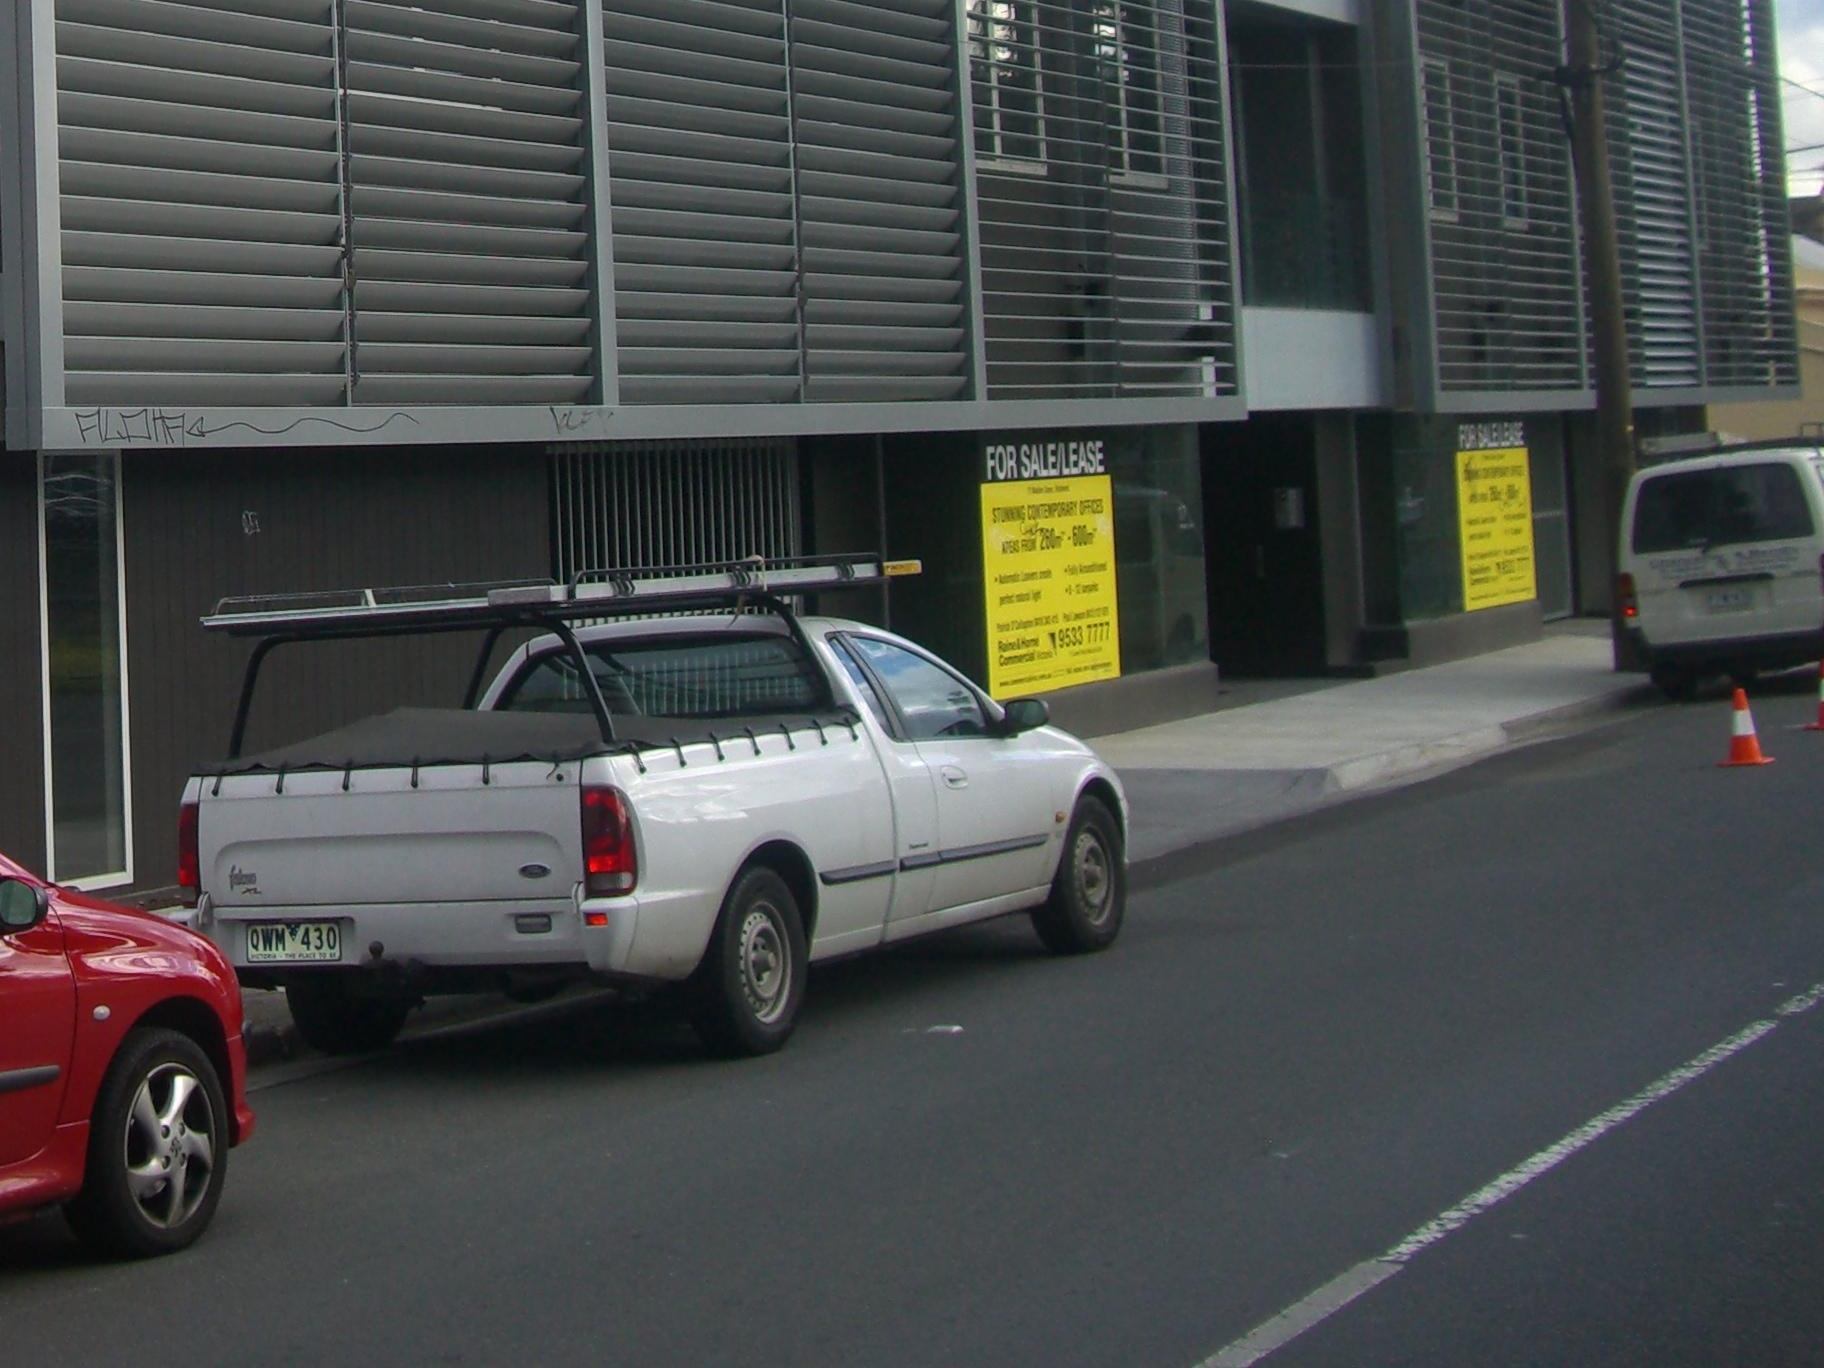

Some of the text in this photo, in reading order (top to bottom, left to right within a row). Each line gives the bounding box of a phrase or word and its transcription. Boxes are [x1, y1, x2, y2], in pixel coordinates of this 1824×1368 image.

[986, 440, 1105, 480] FOR SALE/LEASE
[1027, 500, 1078, 520] CONTEMPORARY
[1079, 498, 1104, 515] OFFICES
[1058, 625, 1084, 649] 9533
[1086, 621, 1110, 644] 7777
[998, 652, 1035, 667] Commercial
[250, 926, 337, 952] QWM 430
